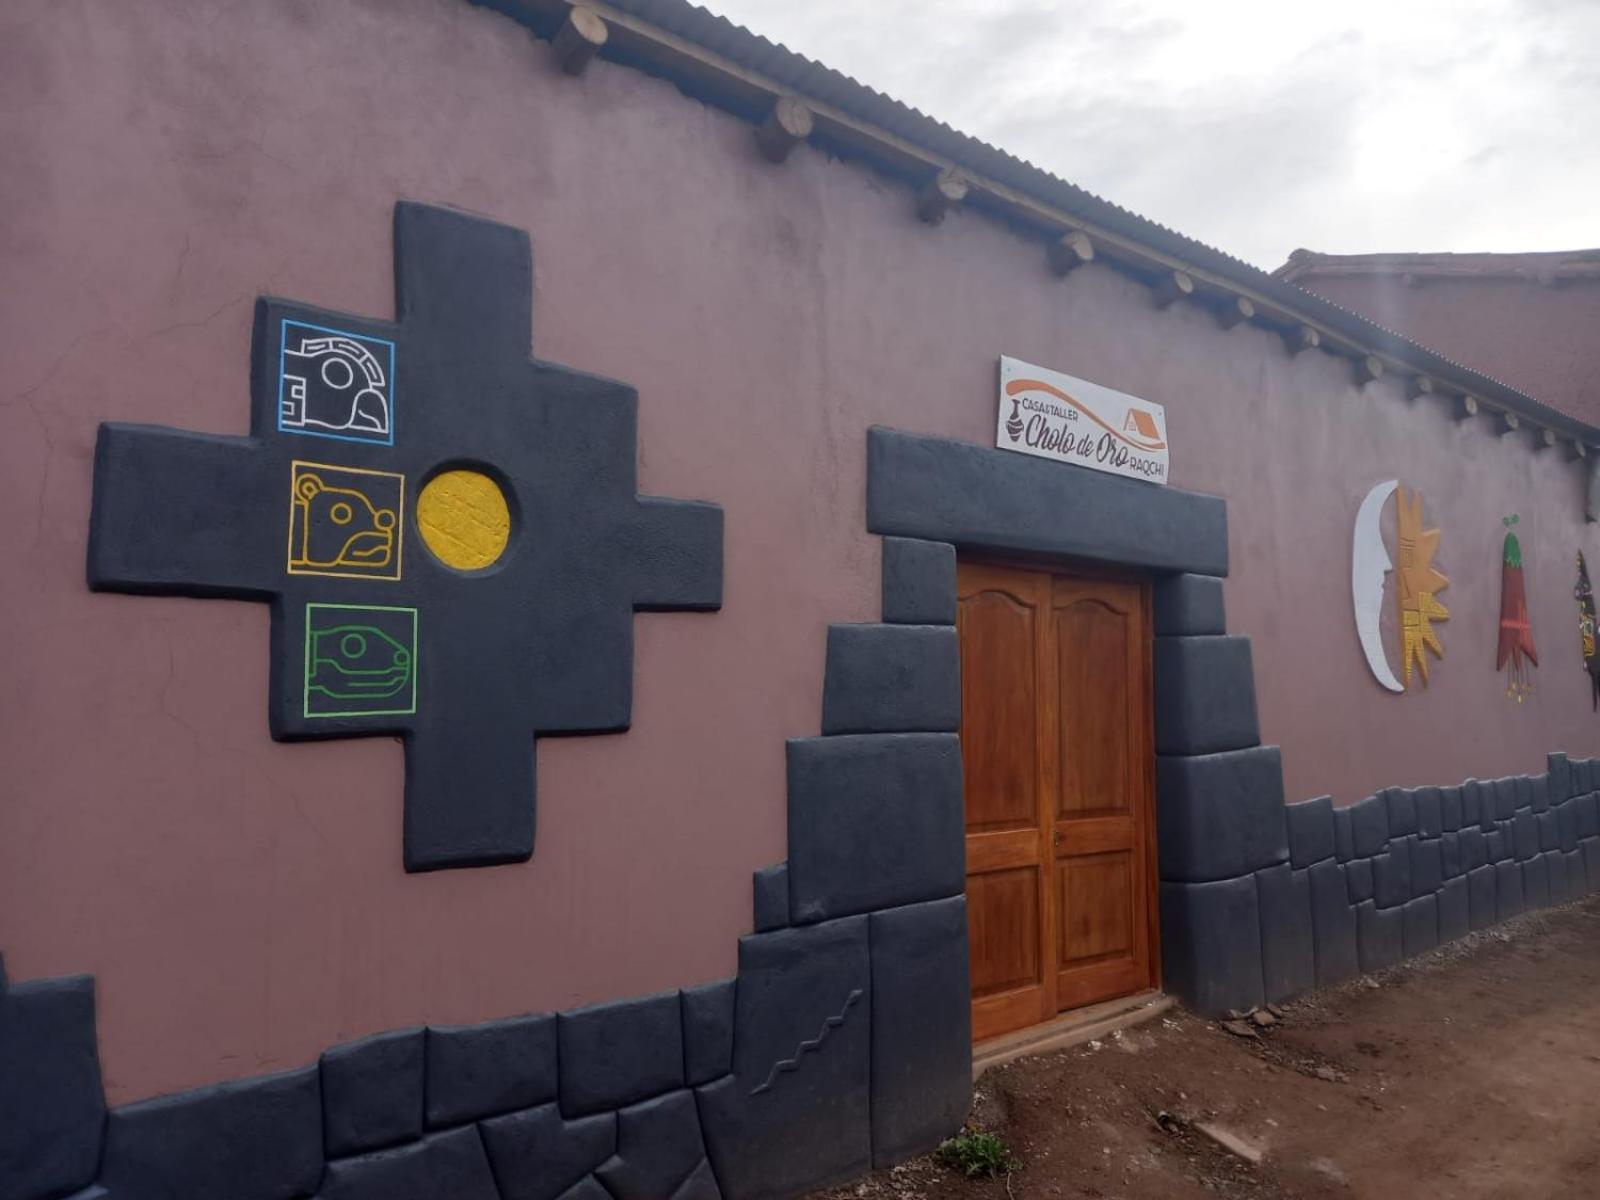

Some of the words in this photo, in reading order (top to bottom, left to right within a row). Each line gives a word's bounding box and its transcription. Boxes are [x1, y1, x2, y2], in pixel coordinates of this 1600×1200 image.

[1025, 414, 1076, 455] Cholo
[1076, 434, 1094, 458] de
[1096, 433, 1129, 467] Oro
[1129, 456, 1164, 476] RAQCHI
